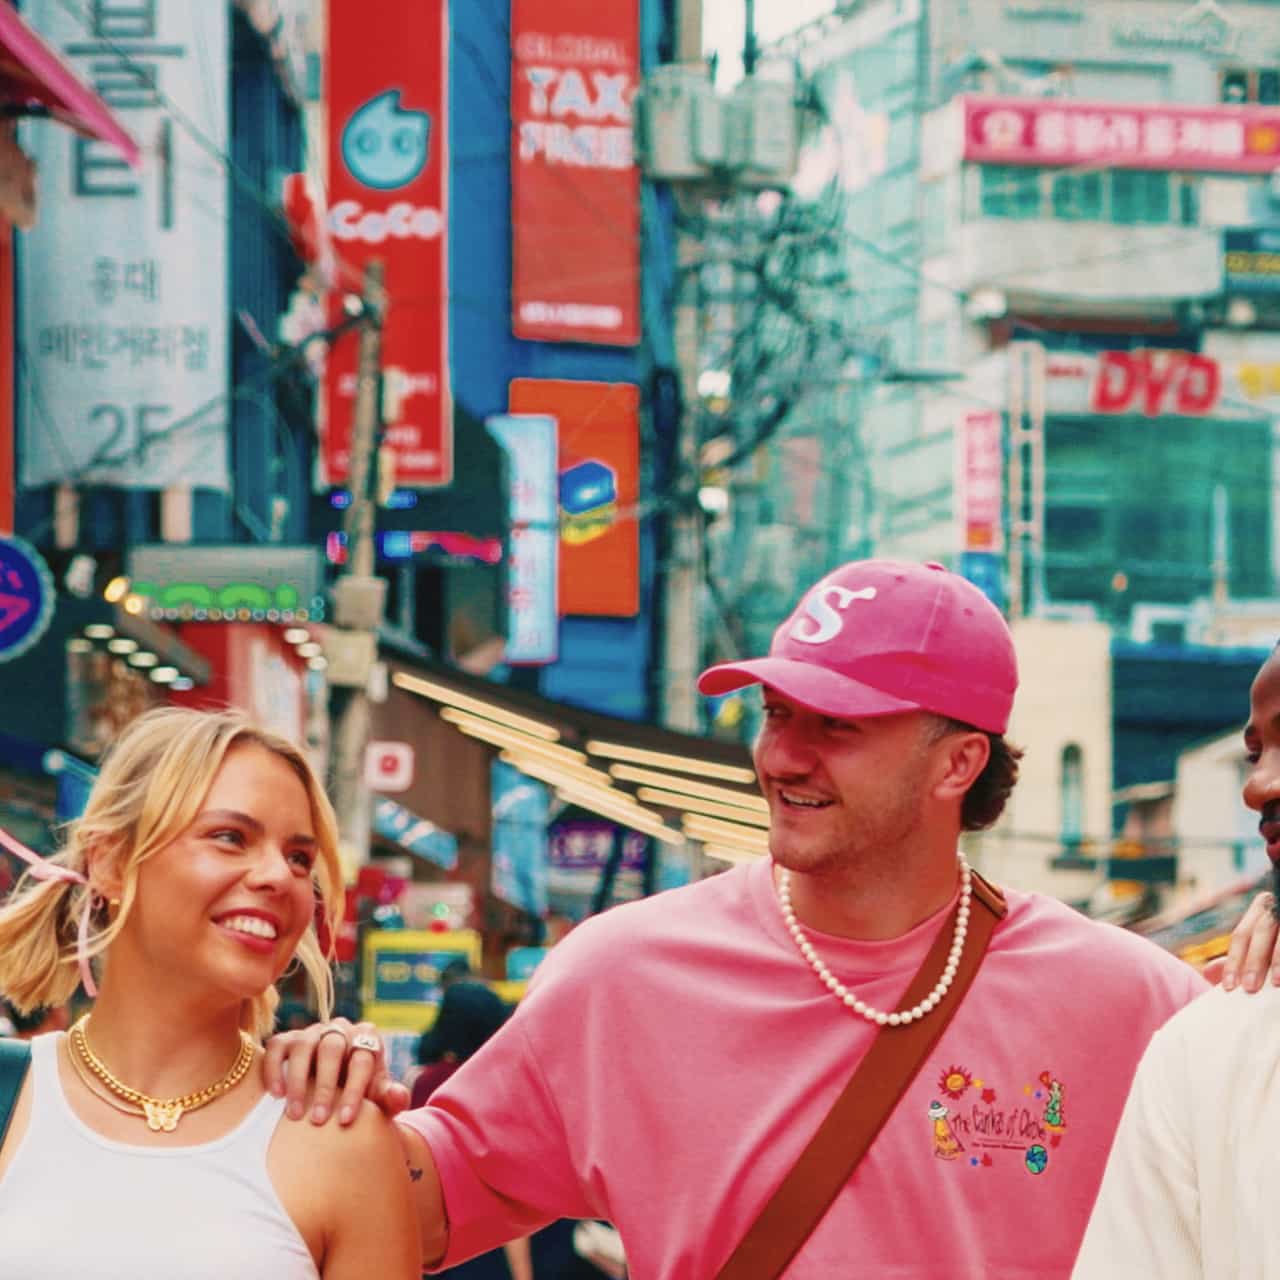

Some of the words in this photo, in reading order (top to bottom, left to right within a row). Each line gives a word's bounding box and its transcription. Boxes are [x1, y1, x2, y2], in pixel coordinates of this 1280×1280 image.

[525, 66, 634, 122] TAX
[520, 122, 634, 169] FREE
[1091, 350, 1221, 415] DVD
[88, 402, 173, 466] 2F
[789, 584, 877, 645] S
